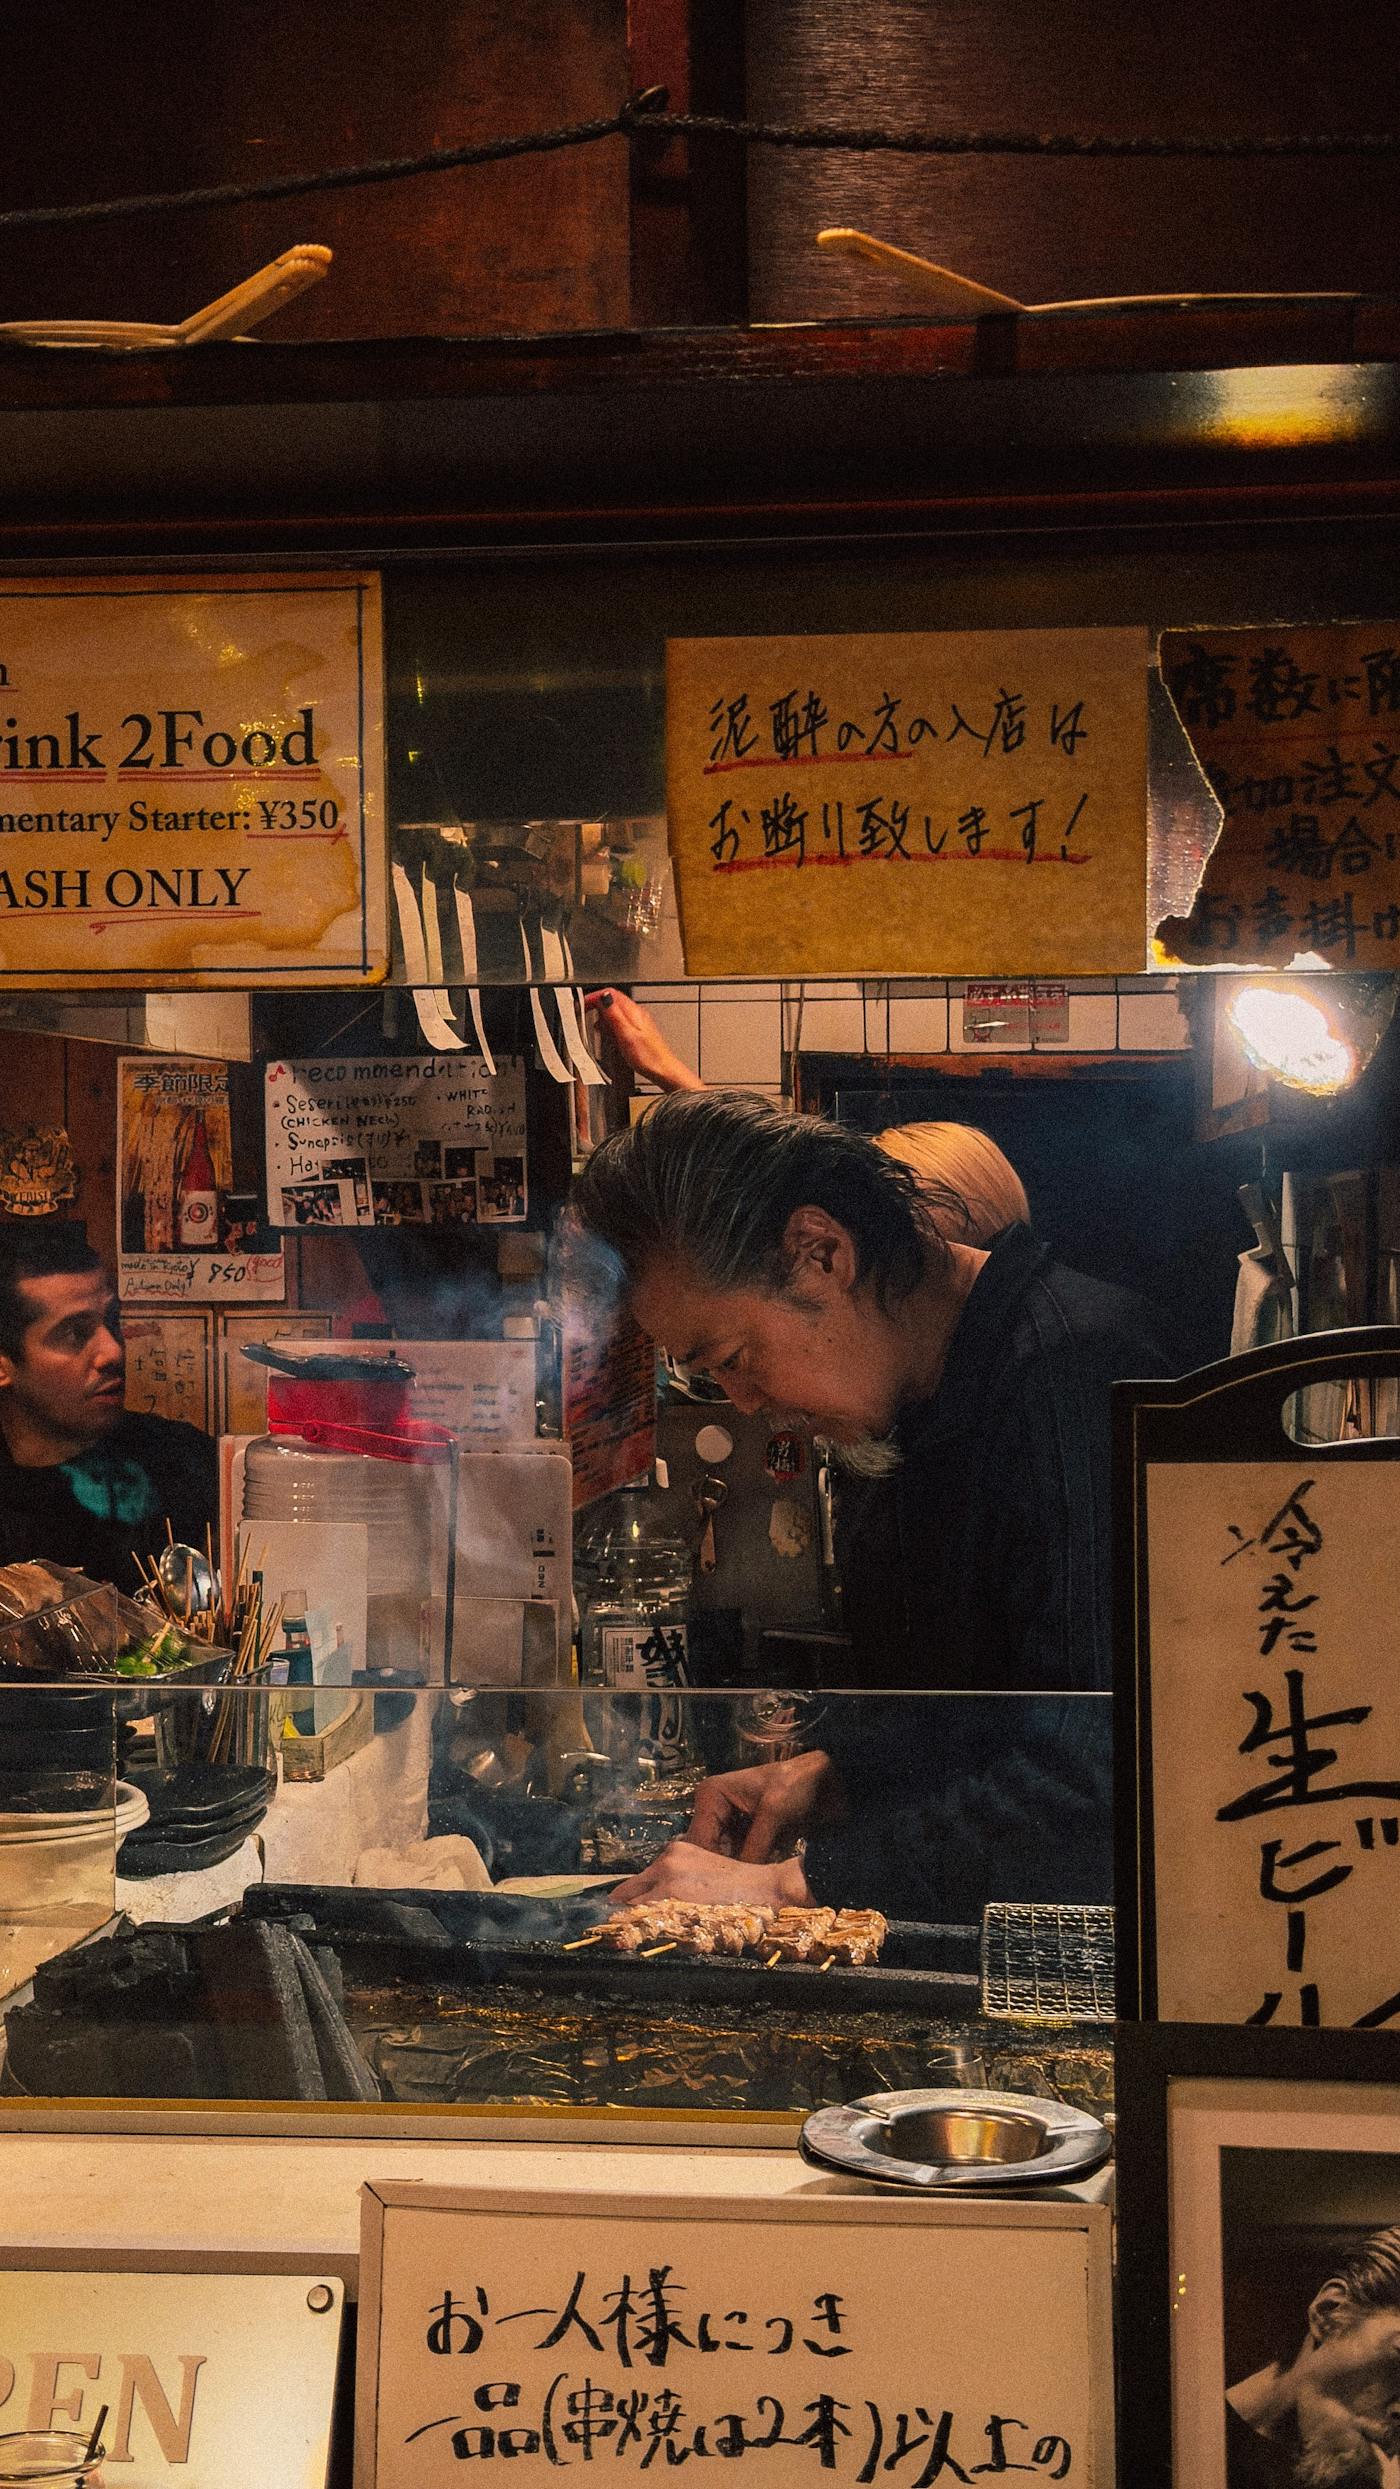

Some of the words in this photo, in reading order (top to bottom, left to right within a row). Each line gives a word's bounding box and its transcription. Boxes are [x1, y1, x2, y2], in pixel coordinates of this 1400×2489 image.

[0, 711, 106, 770] ink
[118, 709, 319, 770] 2Food
[709, 689, 1088, 761] 泥酔の方の入店は
[128, 801, 251, 832] Starter:
[260, 799, 339, 831] ¥350
[105, 867, 252, 908] ONLY
[426, 2264, 854, 2368] お一人様につき
[0, 2352, 207, 2463] EN
